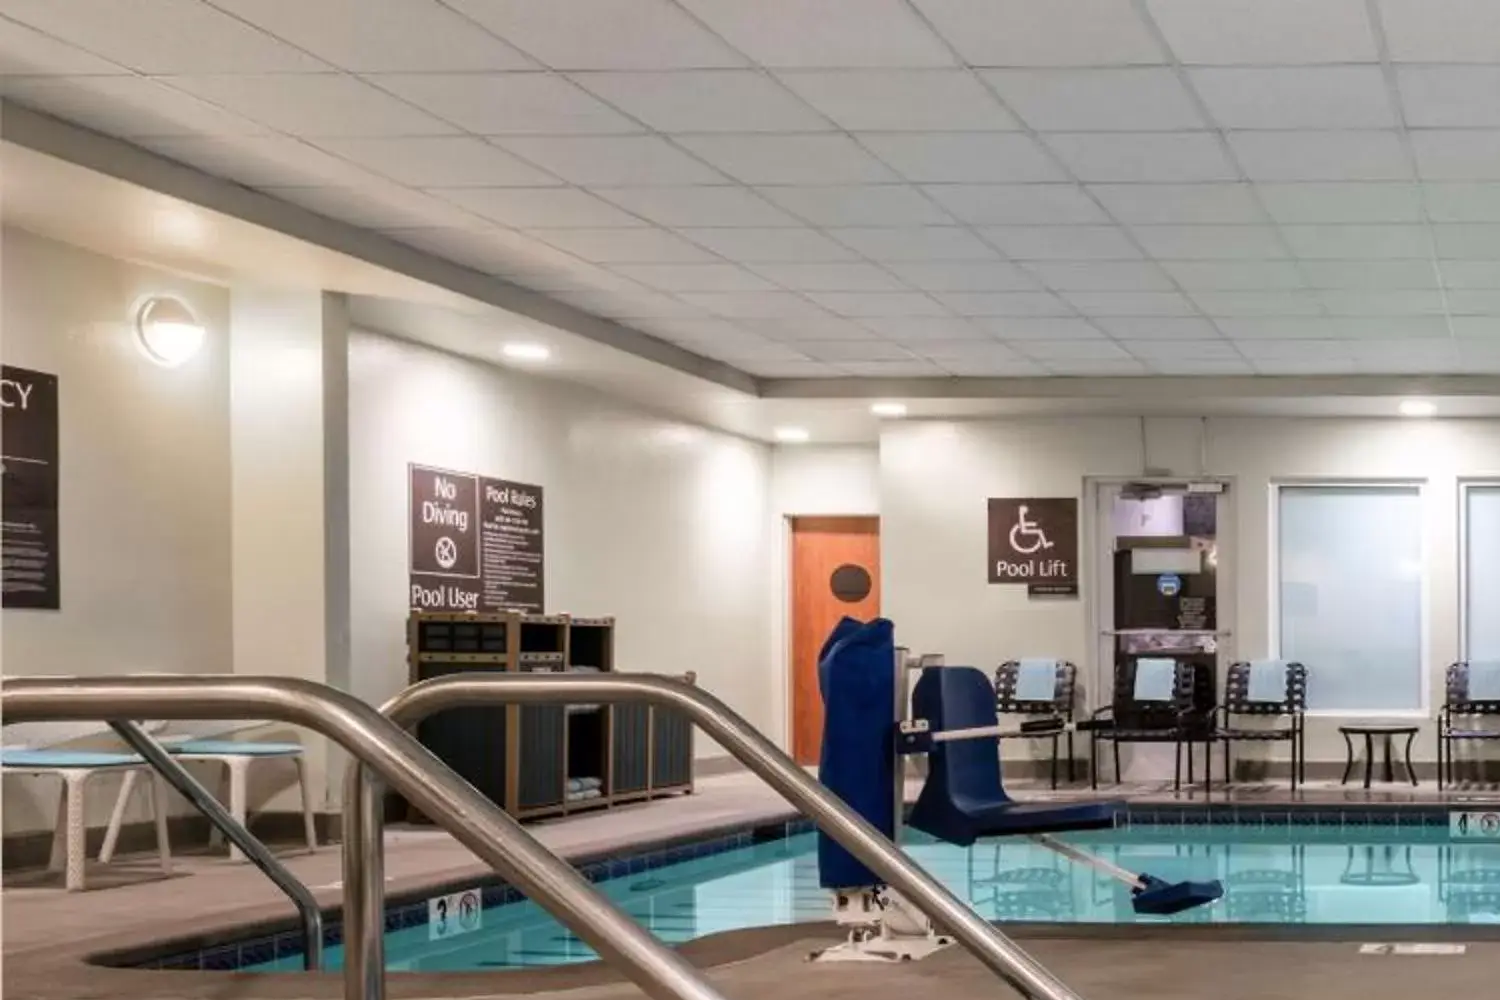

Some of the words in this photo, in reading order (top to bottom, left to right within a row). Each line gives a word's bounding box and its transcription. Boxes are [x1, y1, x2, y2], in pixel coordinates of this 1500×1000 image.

[434, 475, 457, 499] No
[486, 486, 509, 504] Pool
[510, 489, 537, 508] Rules
[422, 500, 468, 532] Diving
[996, 560, 1034, 576] Pool
[1039, 560, 1068, 576] Lift
[411, 584, 446, 607] Pool
[449, 587, 479, 608] User
